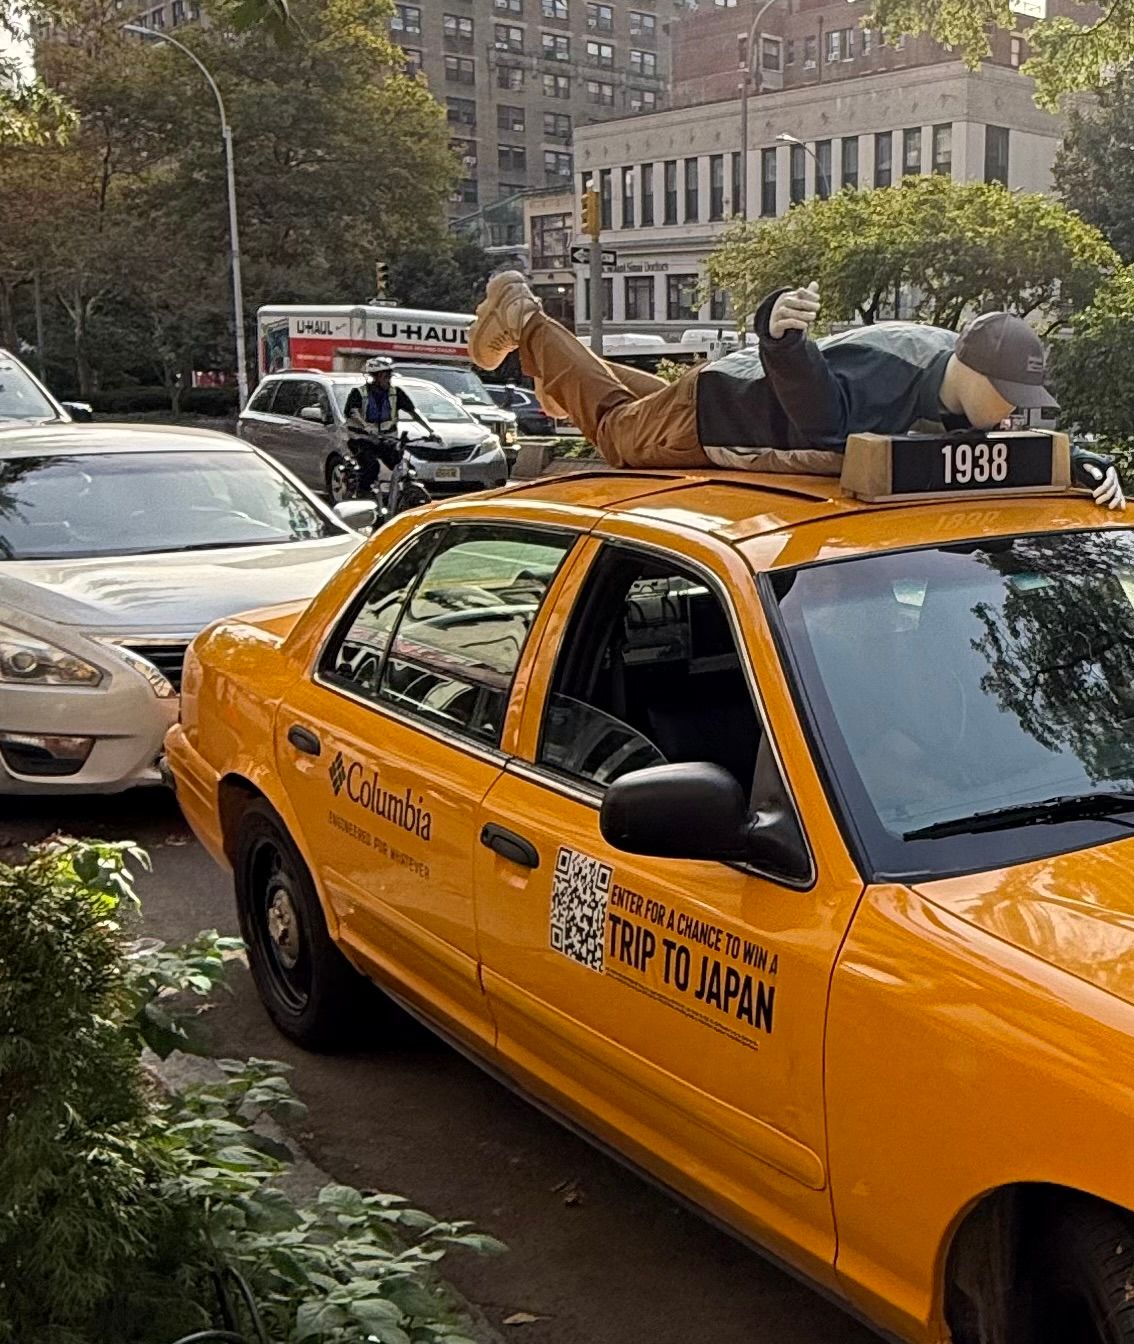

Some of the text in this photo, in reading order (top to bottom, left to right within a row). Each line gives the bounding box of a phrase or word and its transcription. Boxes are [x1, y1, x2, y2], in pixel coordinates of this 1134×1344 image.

[296, 320, 333, 335] U-HAUL
[941, 443, 1008, 484] 1938
[347, 761, 432, 841] Columbia
[611, 884, 778, 975] ENTER FOR A CHANCE TO WIN A
[609, 912, 656, 973] TRIP
[663, 938, 690, 992] TO
[695, 956, 775, 1034] JAPAN
